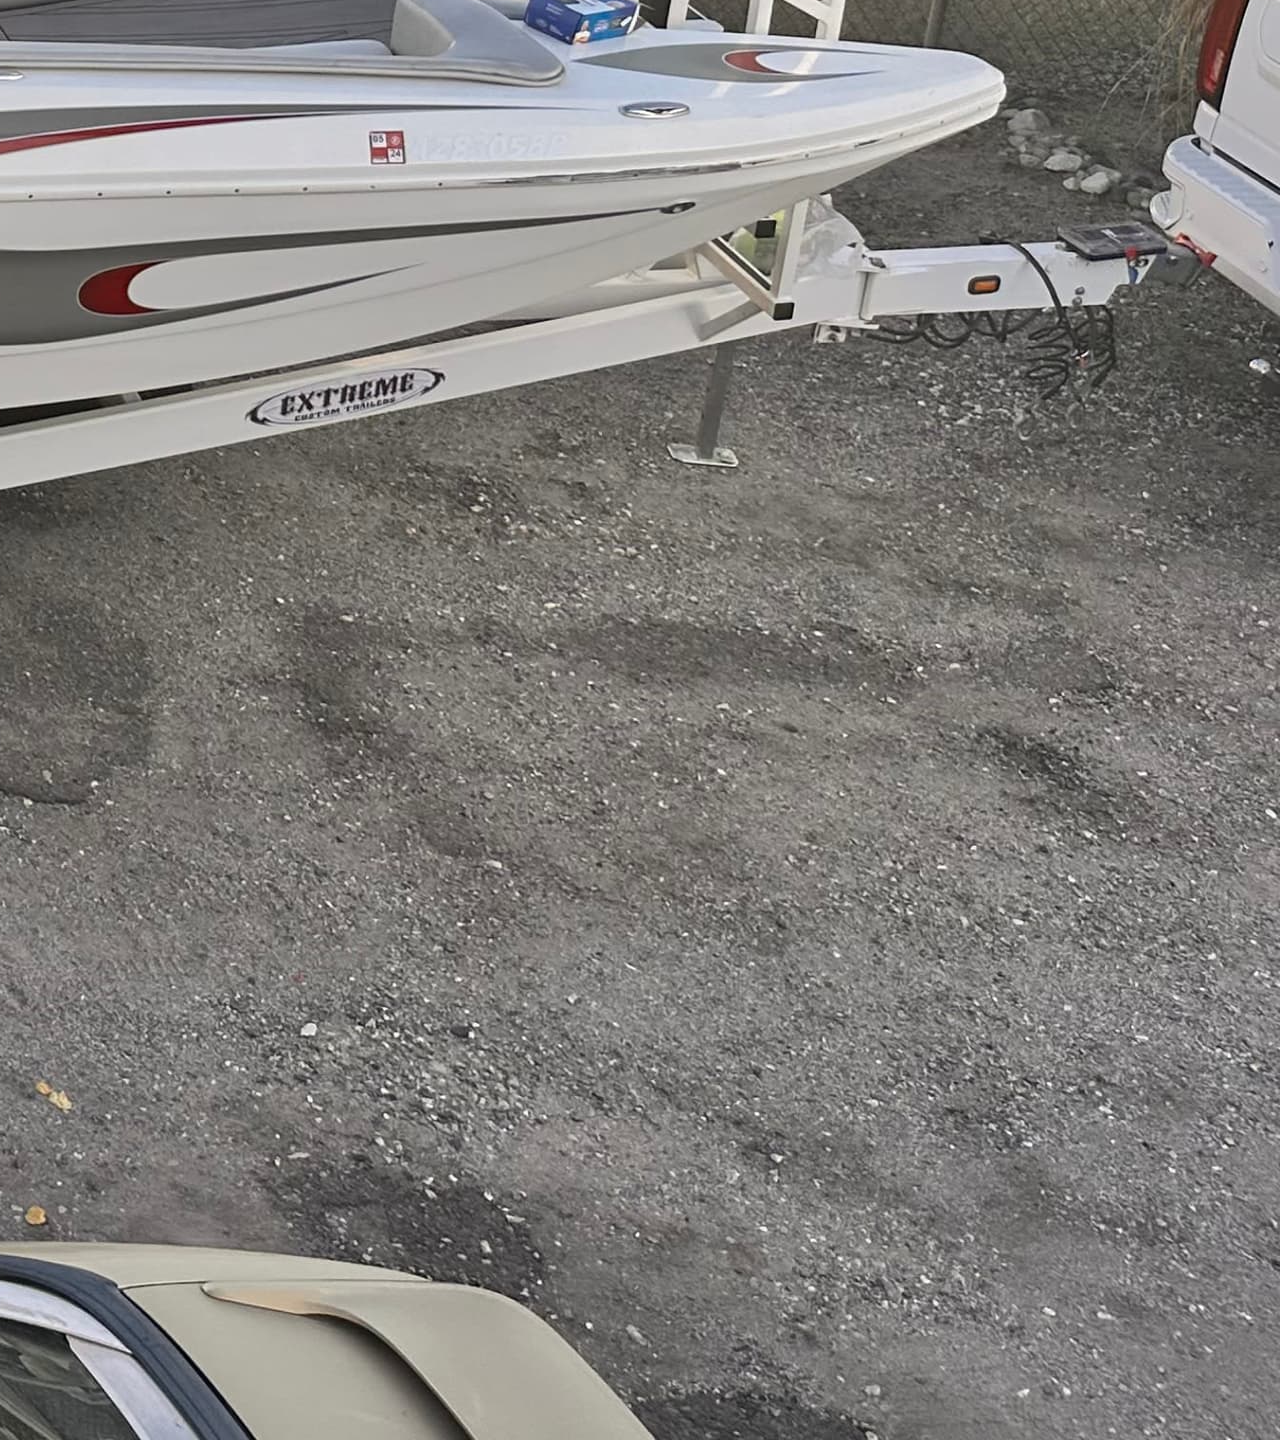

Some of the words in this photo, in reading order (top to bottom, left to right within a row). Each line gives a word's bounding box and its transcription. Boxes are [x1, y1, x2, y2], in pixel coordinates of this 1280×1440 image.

[372, 135, 384, 143] 05
[390, 149, 401, 158] 24
[280, 372, 416, 416] EXTREME
[294, 407, 340, 422] CUSTOM
[344, 397, 396, 413] TRAILERS
